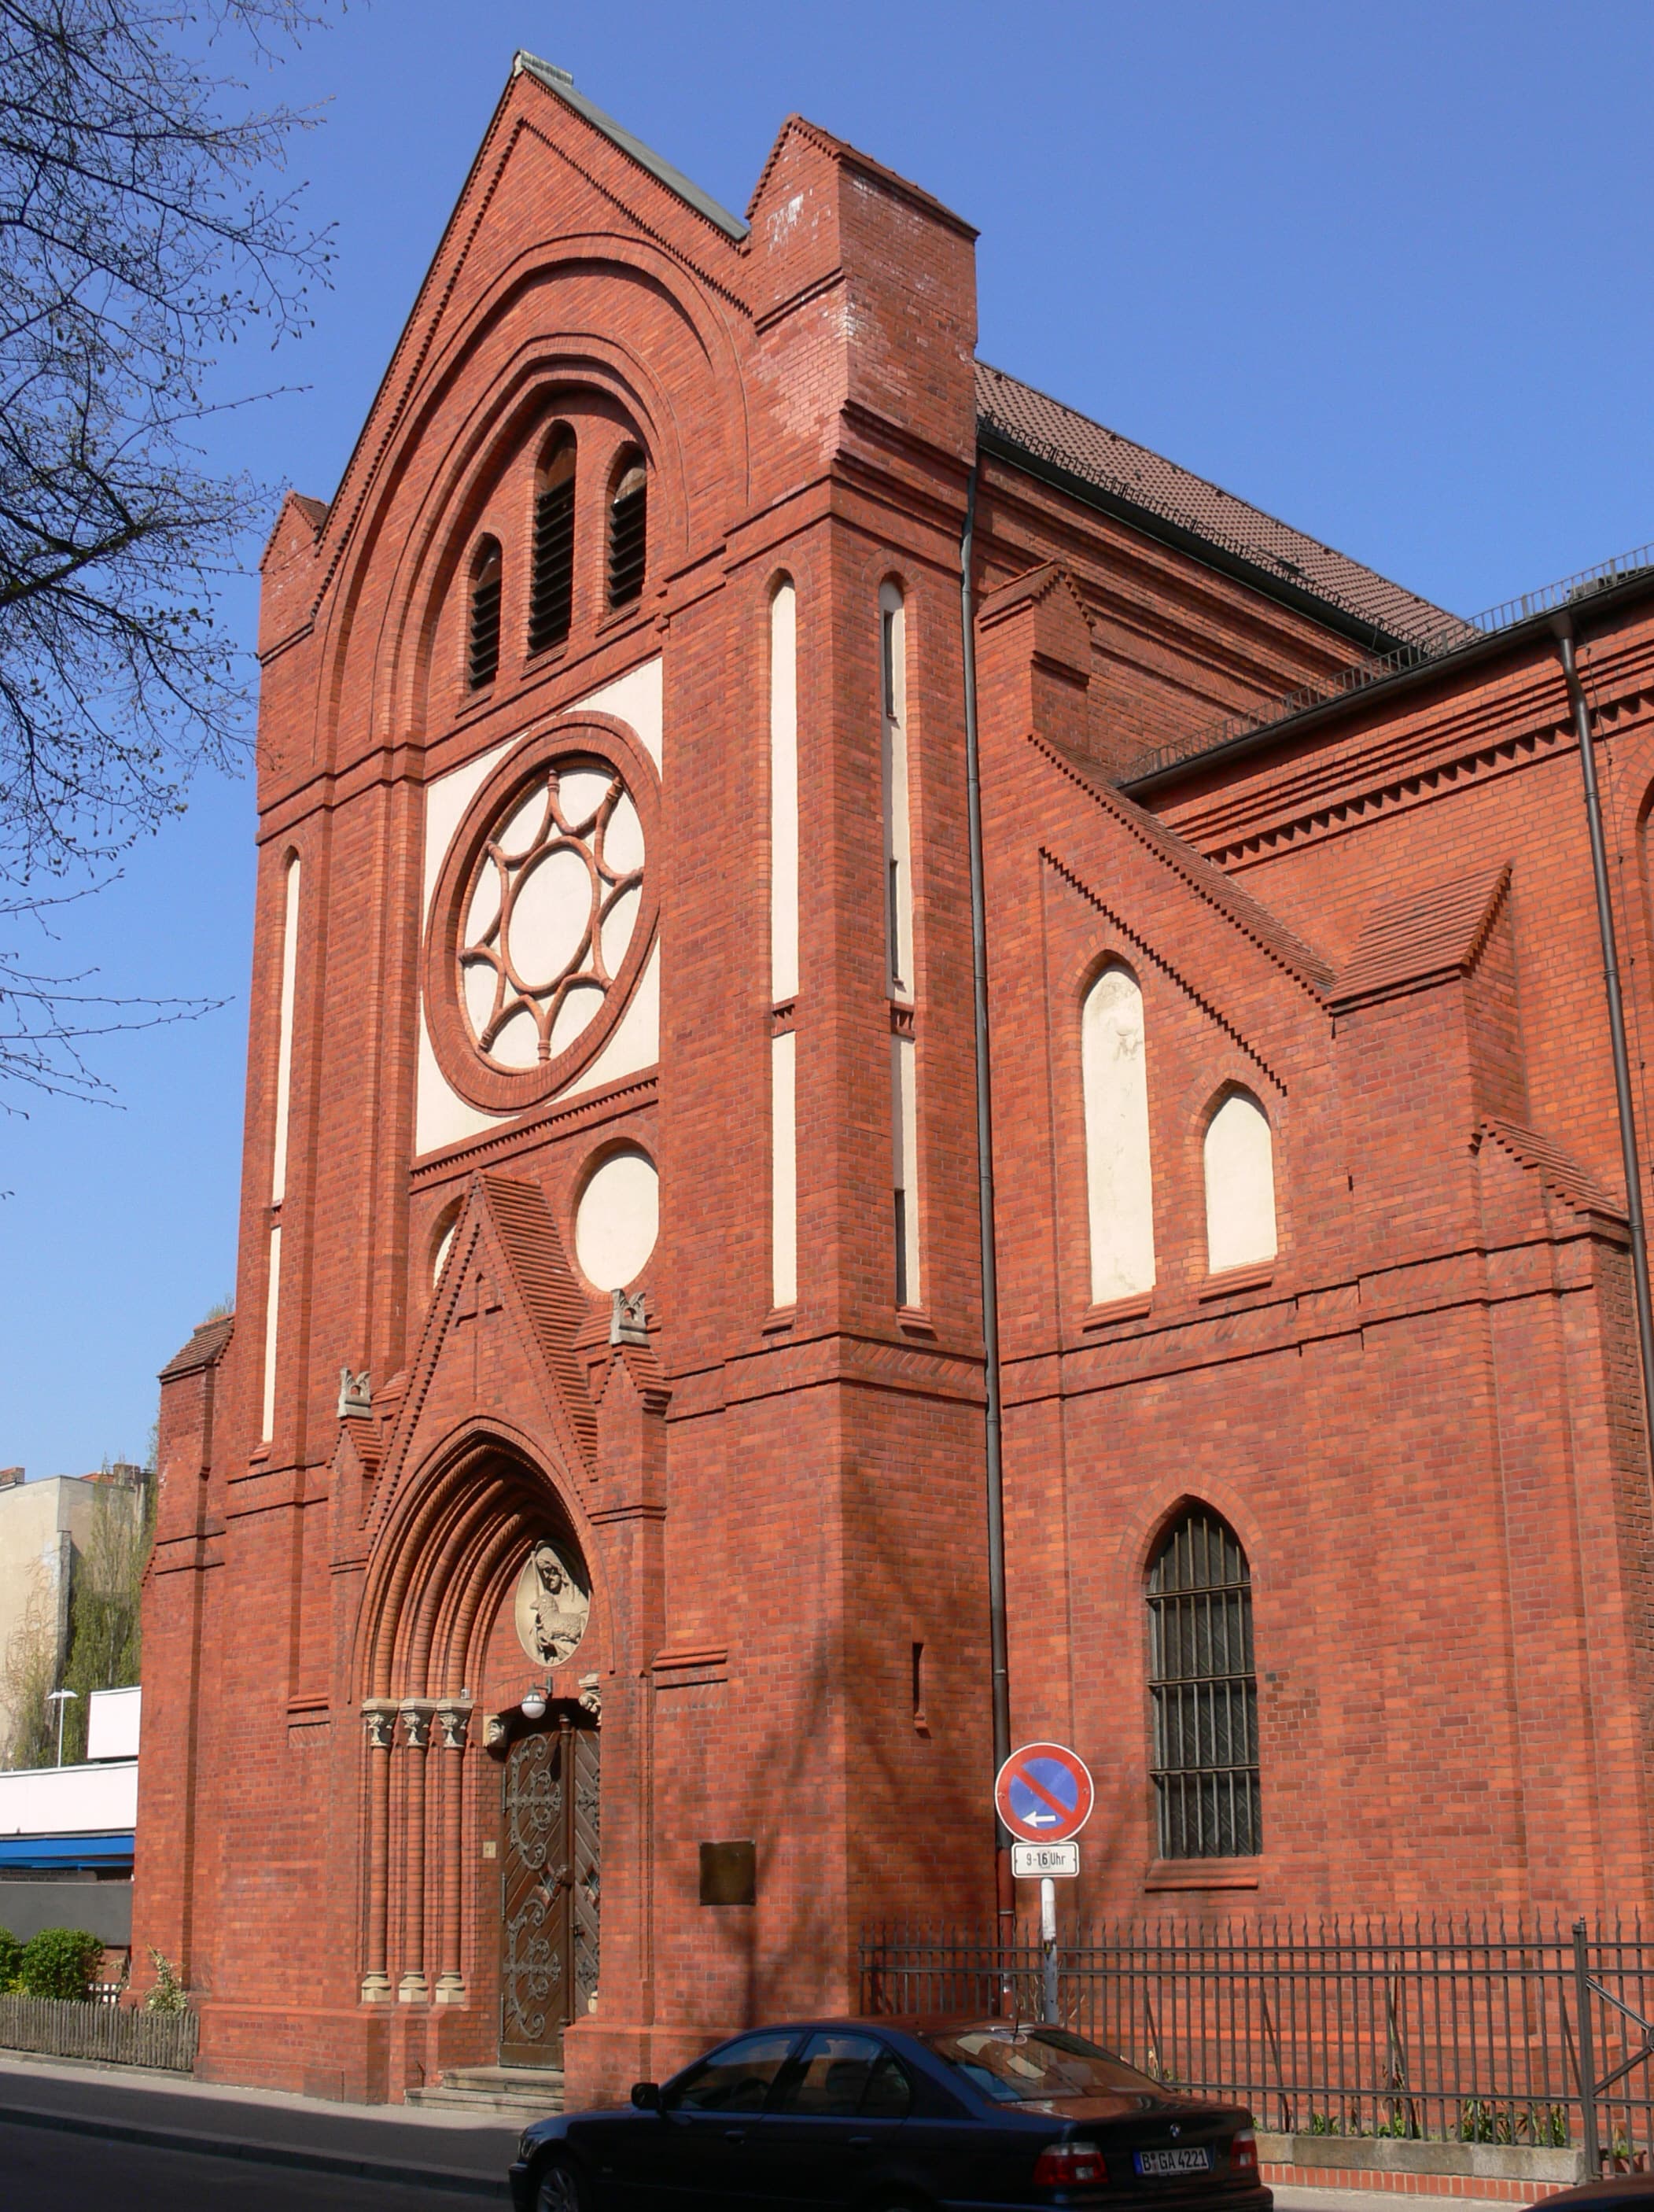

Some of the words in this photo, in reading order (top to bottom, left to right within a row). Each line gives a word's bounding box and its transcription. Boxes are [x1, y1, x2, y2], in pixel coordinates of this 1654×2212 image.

[1051, 1852, 1066, 1866] Uhr
[1143, 2154, 1151, 2171] B
[1159, 2152, 1176, 2170] GA
[1178, 2150, 1207, 2168] 4221
